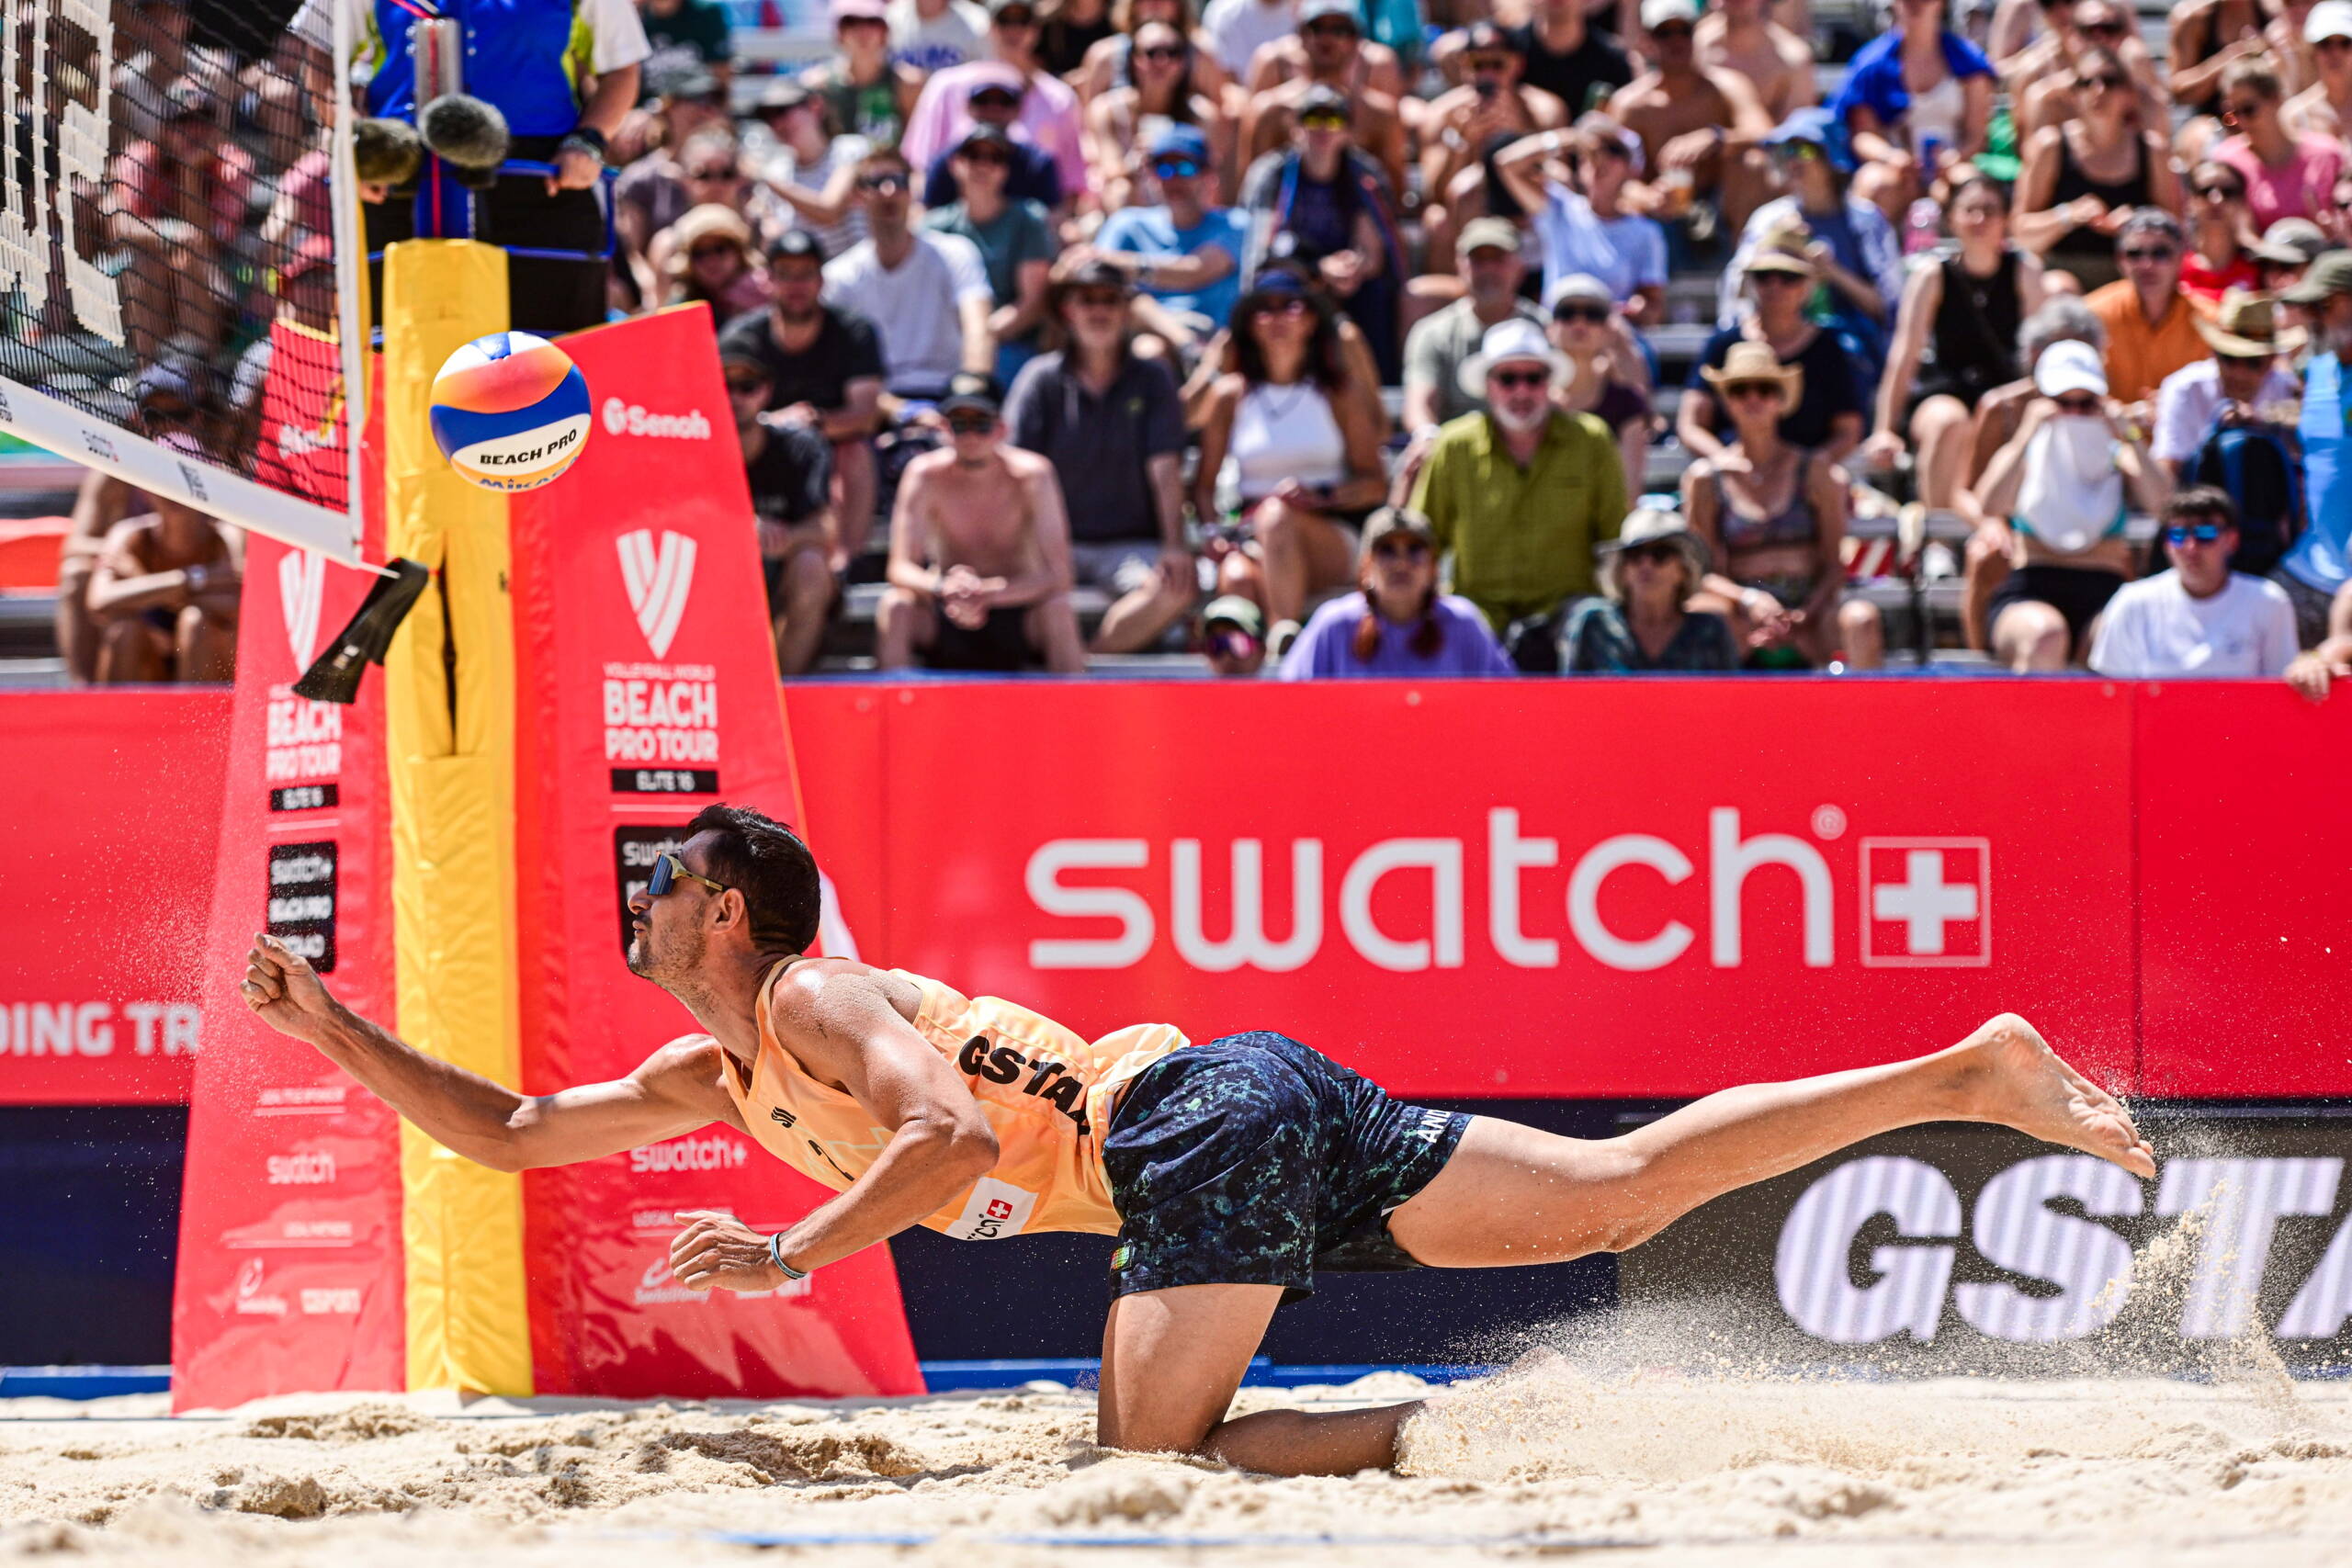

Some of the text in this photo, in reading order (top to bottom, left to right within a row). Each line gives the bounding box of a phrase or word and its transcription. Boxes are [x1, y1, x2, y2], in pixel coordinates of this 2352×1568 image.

[626, 404, 711, 440] Senoh
[480, 429, 577, 465] BEACH PRO
[266, 699, 343, 748] BEACH
[604, 679, 718, 728] BEACH
[605, 727, 719, 762] PRO TOUR
[1023, 807, 1835, 972] swatch
